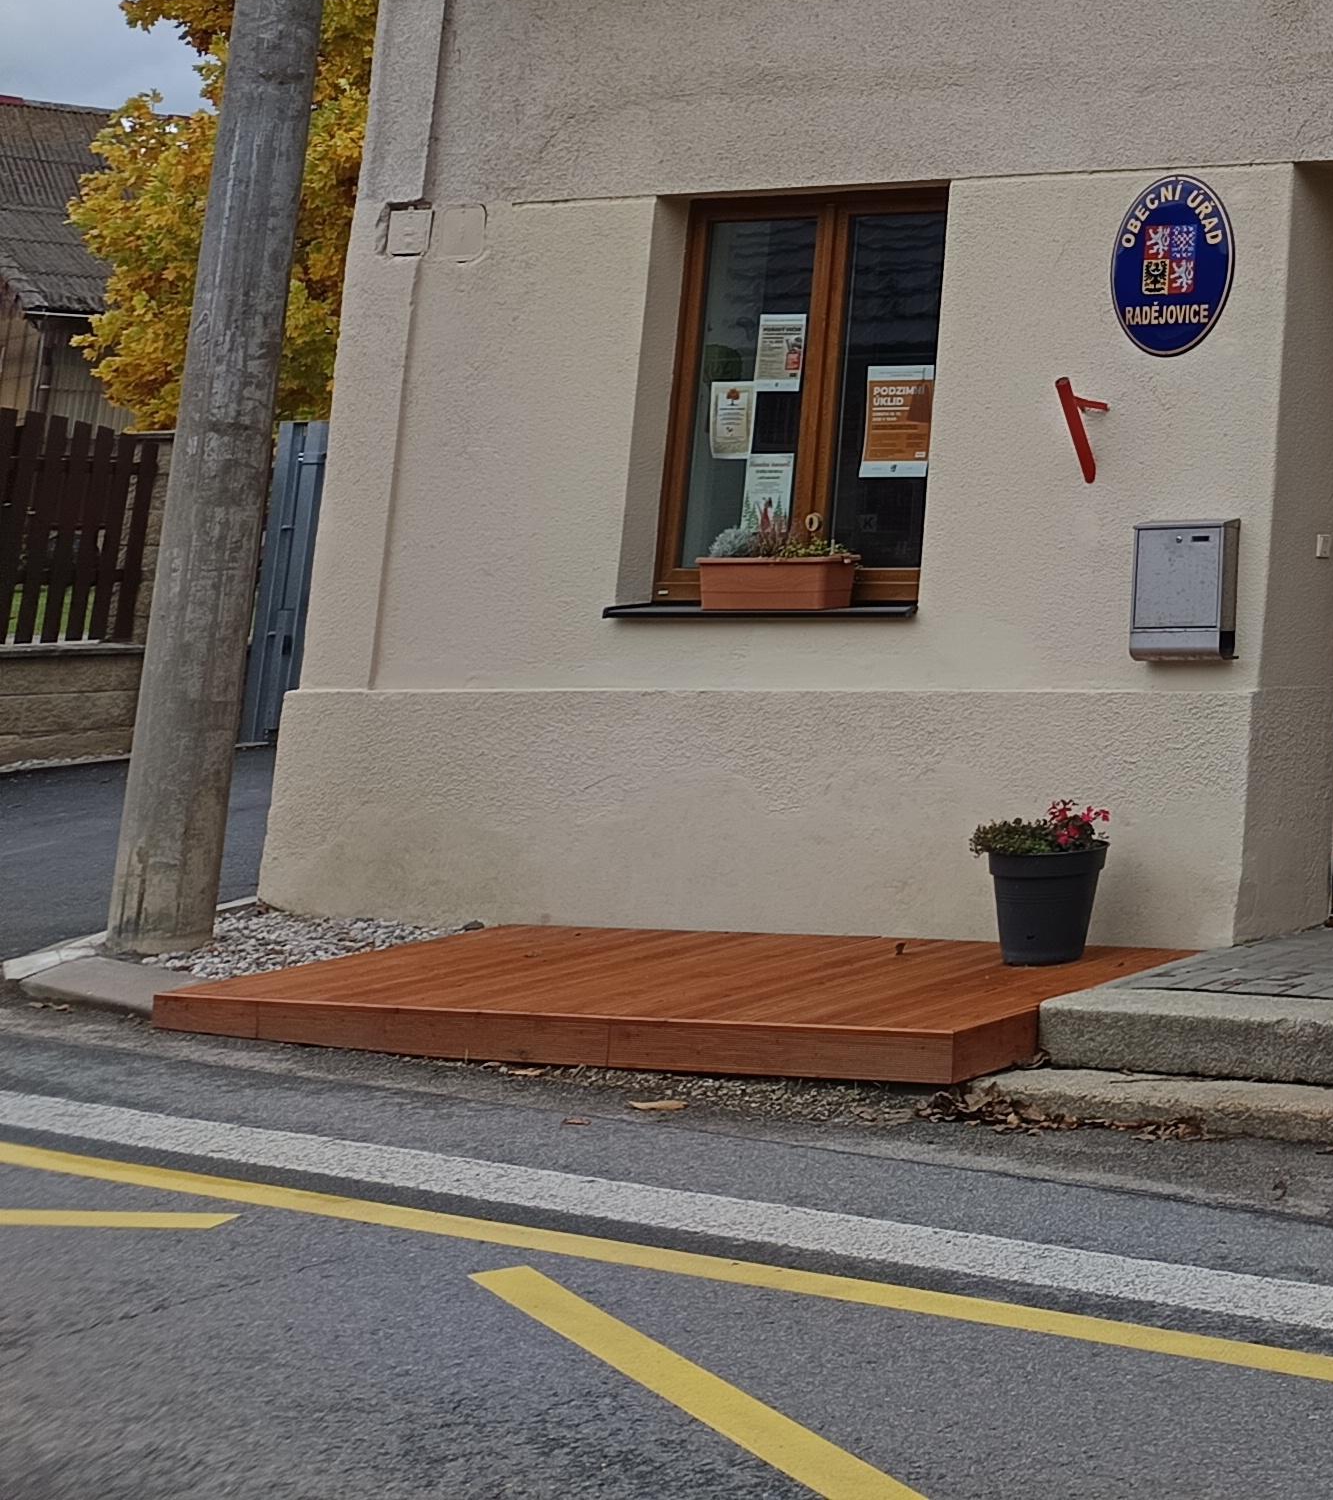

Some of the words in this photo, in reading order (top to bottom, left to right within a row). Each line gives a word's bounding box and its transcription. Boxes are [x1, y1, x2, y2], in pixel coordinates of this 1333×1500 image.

[1121, 181, 1184, 248] OBECNÍ
[1186, 189, 1223, 245] ÚŘAD
[1125, 301, 1209, 325] RADĚJOVICE
[873, 395, 904, 406] ÚKLID
